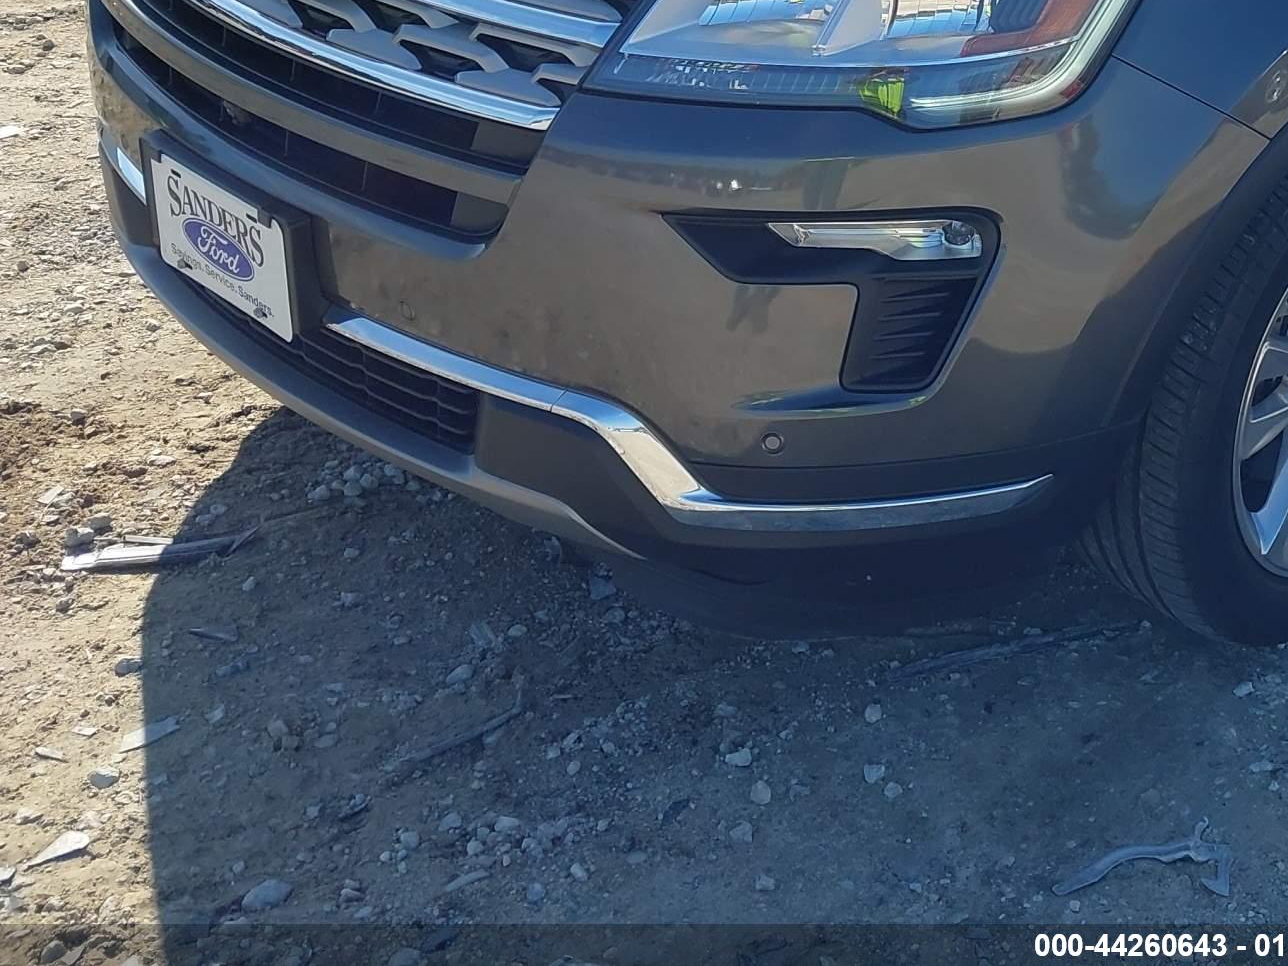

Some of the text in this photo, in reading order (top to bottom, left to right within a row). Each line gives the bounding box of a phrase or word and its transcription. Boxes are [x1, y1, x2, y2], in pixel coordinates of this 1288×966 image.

[167, 175, 264, 268] SANDERS
[197, 224, 240, 274] Ford
[238, 285, 275, 317] Sanders.
